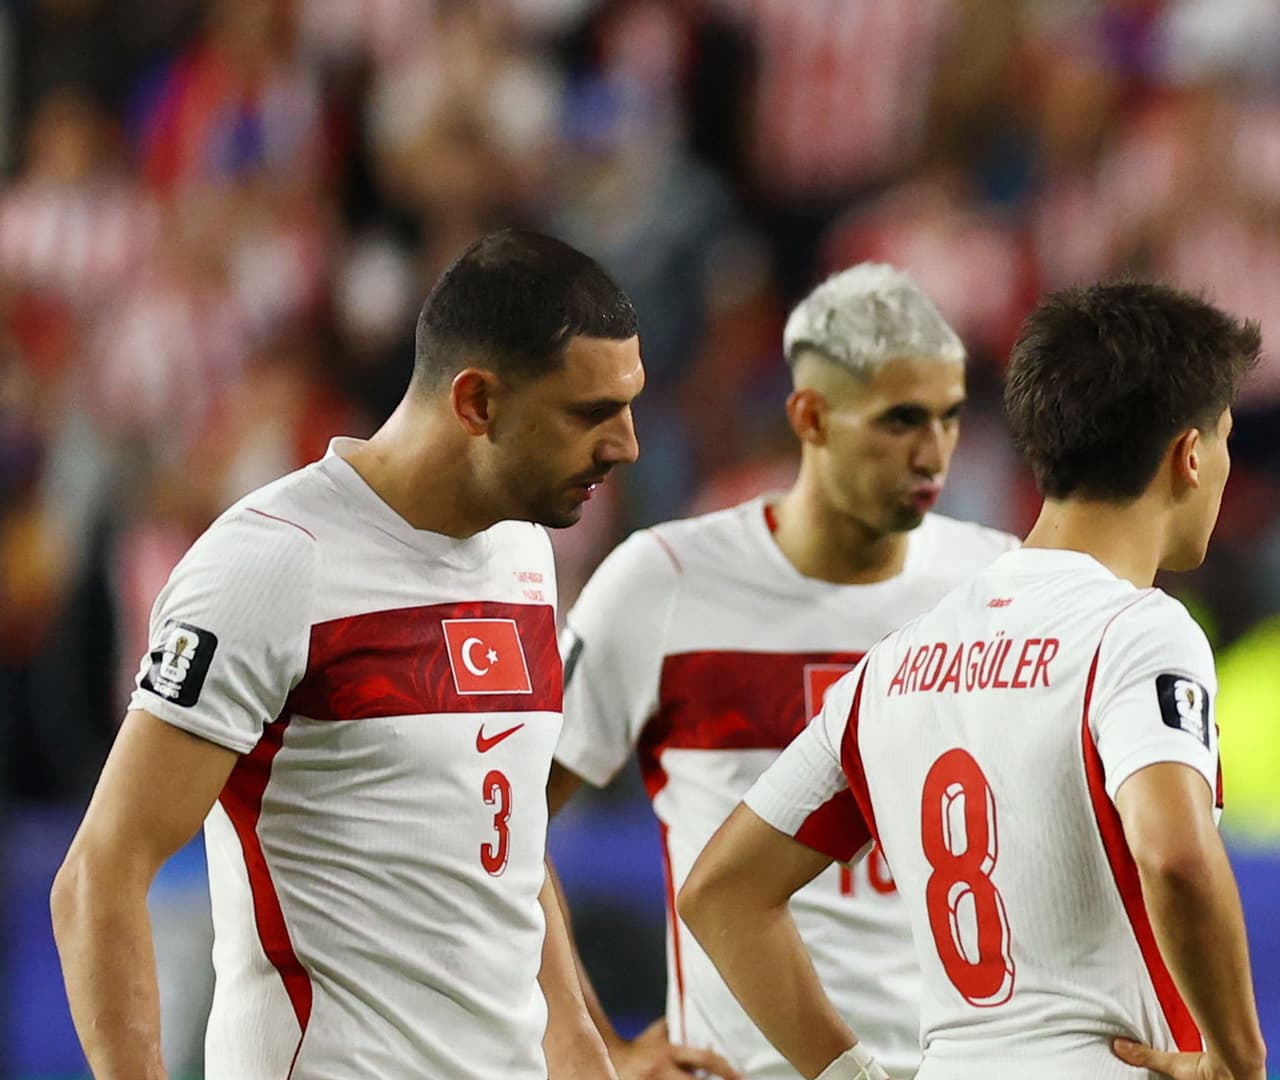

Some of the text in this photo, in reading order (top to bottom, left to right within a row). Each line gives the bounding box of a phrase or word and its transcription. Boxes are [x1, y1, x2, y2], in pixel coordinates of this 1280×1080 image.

[887, 630, 1060, 697] ARDAGÜLER
[479, 769, 512, 876] 3
[920, 747, 1017, 1009] 8
